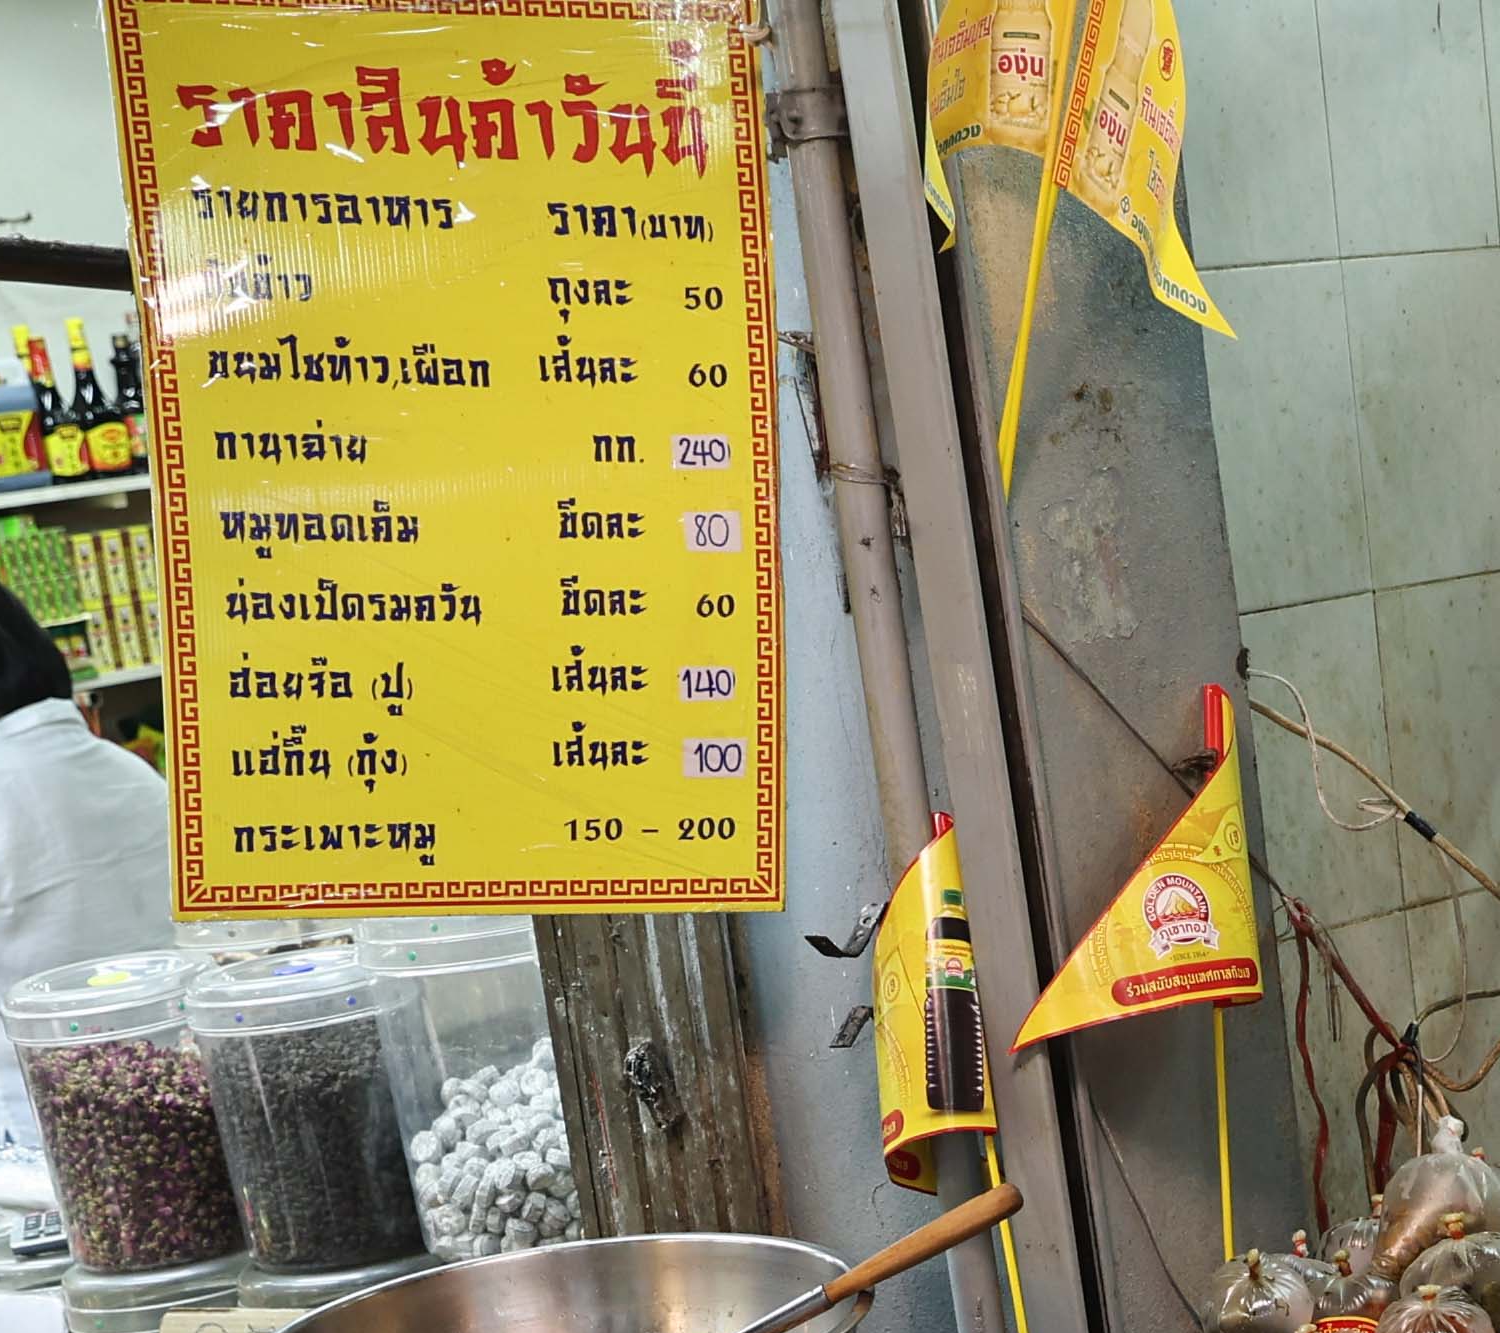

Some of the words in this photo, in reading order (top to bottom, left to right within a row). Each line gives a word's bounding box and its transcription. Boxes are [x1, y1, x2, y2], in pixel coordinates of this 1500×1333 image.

[998, 47, 1045, 81] องุ่น
[177, 39, 707, 178] ราคาสินค้าวันนี้
[1099, 108, 1127, 147] องุ่น
[192, 189, 454, 231] รายการอาหาร
[548, 275, 634, 324] ถุงละ
[684, 286, 724, 312] 50
[539, 336, 640, 385] เส้นละ
[688, 363, 728, 390] 60
[592, 433, 645, 465] กก.
[678, 437, 728, 467] 240
[220, 499, 420, 560] หมูทอดเค็ม
[557, 499, 648, 541] ขีดละ
[693, 516, 729, 548] 80
[226, 578, 483, 626] น่องเป็ดรมควัน
[561, 576, 650, 619] ขีดละ
[695, 593, 736, 620] 60
[370, 660, 414, 717] (ปู)
[551, 645, 650, 694] เส้นละ
[680, 669, 733, 698] 140
[347, 731, 409, 794] (กุ้ง)
[552, 721, 650, 769] เส้นละ
[692, 744, 743, 774] 100
[234, 820, 437, 867] กระเพาะหมู
[564, 817, 624, 844] 150
[677, 816, 738, 842] 200
[1148, 879, 1166, 922] GOLDEN
[1166, 876, 1208, 914] MOUNTAIN
[1160, 922, 1208, 941] ภูเขาทอง
